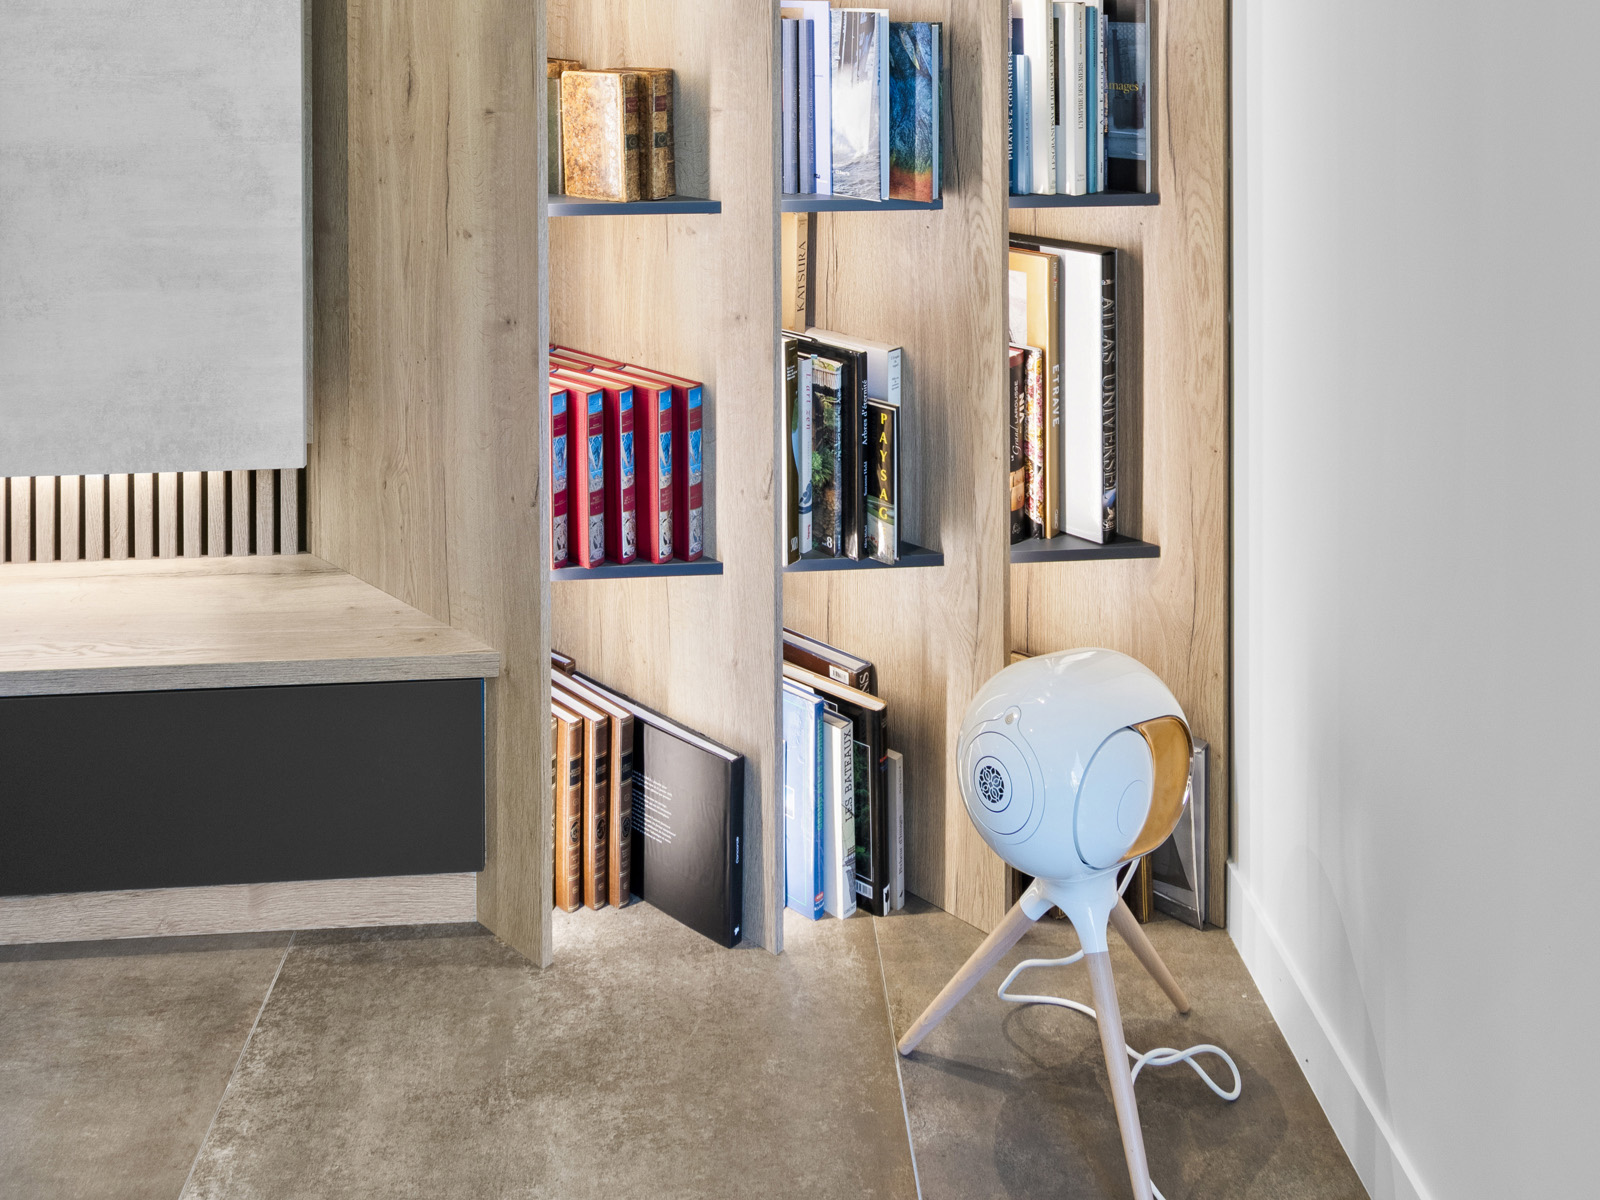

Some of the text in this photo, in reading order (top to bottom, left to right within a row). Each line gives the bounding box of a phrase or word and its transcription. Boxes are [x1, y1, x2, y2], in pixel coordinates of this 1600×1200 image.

[796, 240, 807, 312] KATSURA
[1101, 296, 1116, 494] ATLAS UNIVERSEL
[1010, 424, 1022, 456] Grand
[826, 536, 833, 549] 8
[860, 671, 869, 694] NS
[843, 728, 854, 822] LES BATEAUX
